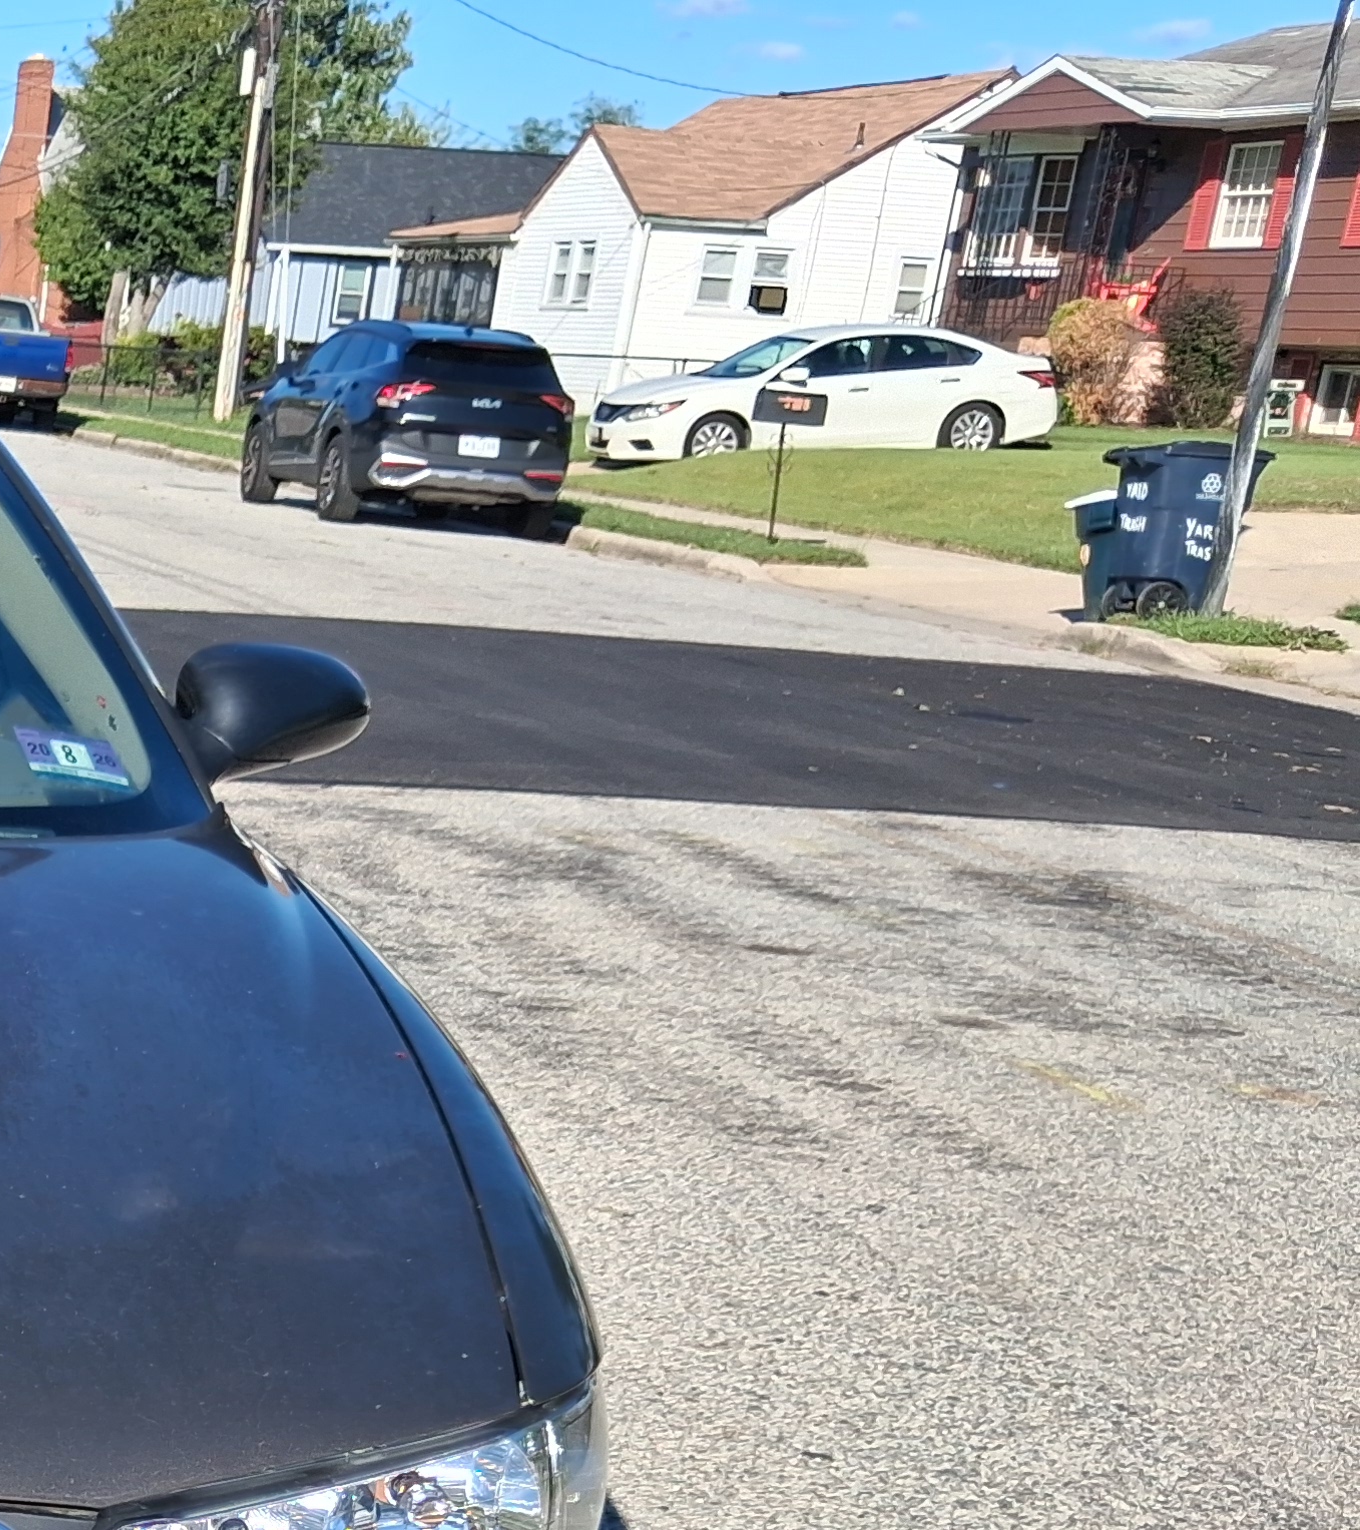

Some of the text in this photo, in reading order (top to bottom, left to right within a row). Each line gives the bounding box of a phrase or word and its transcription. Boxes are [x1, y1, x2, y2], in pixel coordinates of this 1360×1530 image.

[1186, 518, 1214, 540] YAR
[1185, 540, 1211, 561] TRAS
[27, 742, 50, 756] 20
[61, 744, 78, 764] 8
